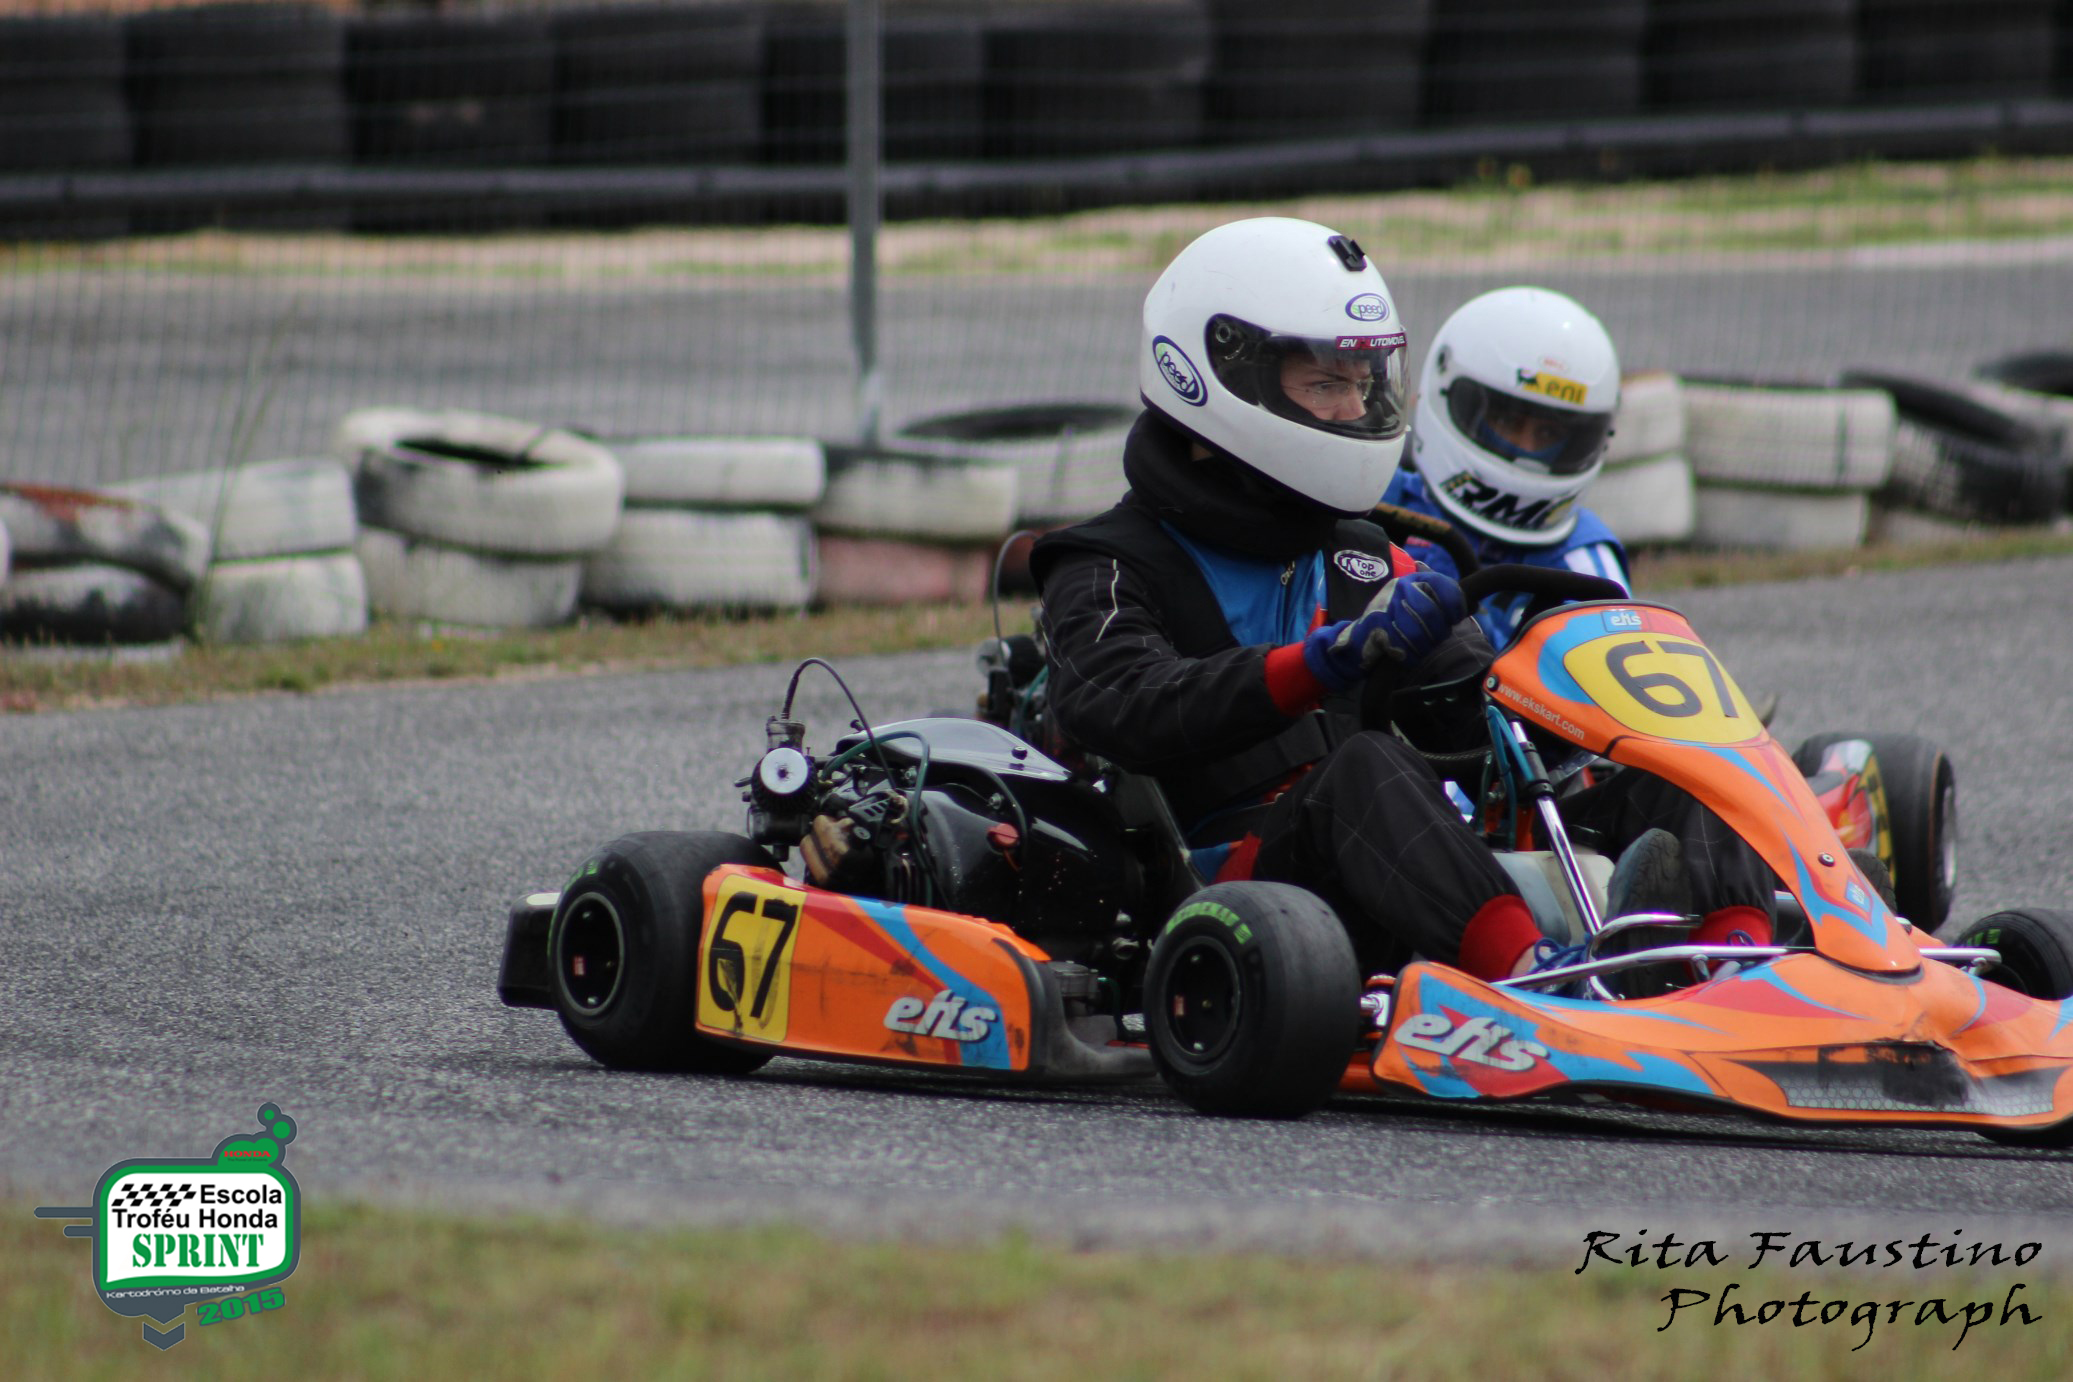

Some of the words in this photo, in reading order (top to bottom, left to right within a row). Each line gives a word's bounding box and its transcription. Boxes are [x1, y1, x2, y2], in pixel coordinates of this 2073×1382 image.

[1545, 380, 1584, 404] eni
[1497, 682, 1586, 741] www.ekskart.com
[1605, 639, 1741, 720] 67
[708, 889, 800, 1020] 67
